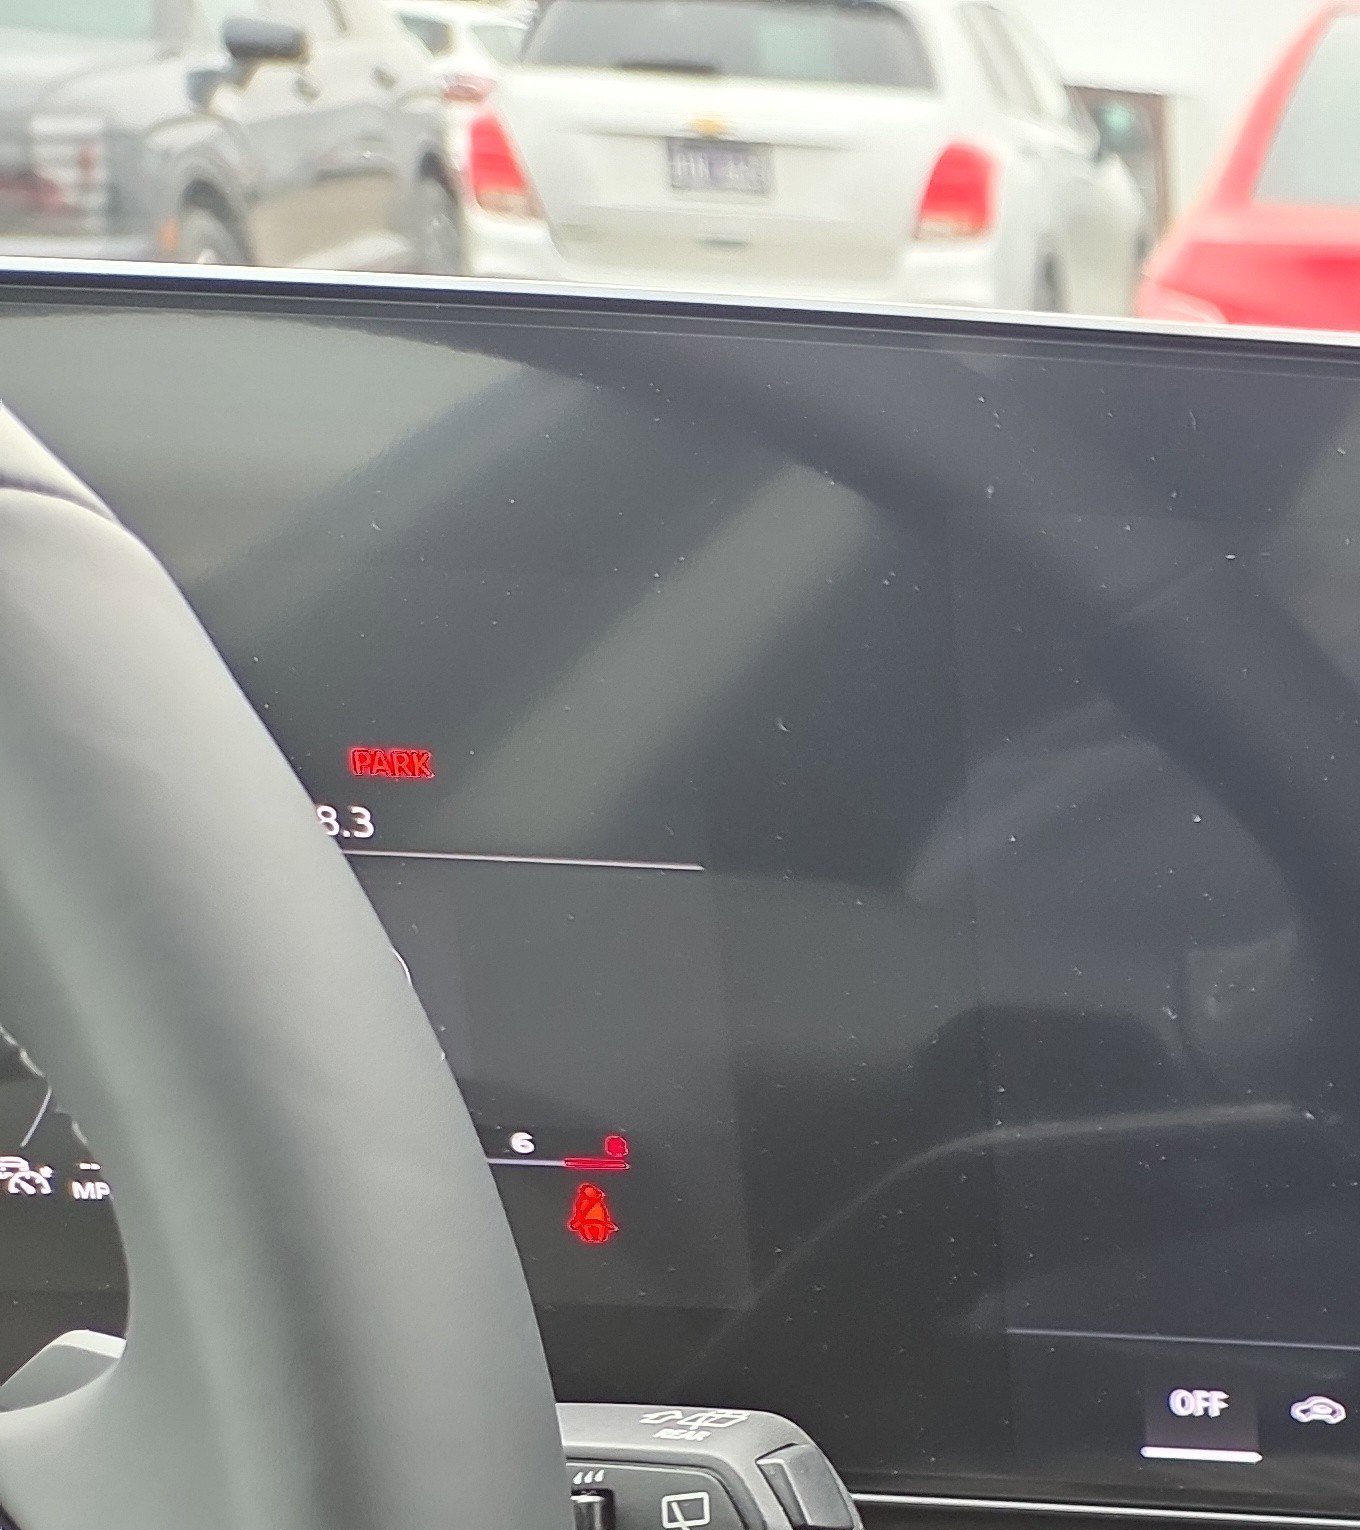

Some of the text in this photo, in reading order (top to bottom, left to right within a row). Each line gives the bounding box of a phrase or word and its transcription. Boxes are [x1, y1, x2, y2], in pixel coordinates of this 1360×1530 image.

[351, 748, 435, 778] PARK
[71, 1180, 112, 1200] MP
[1168, 1388, 1231, 1419] OFF
